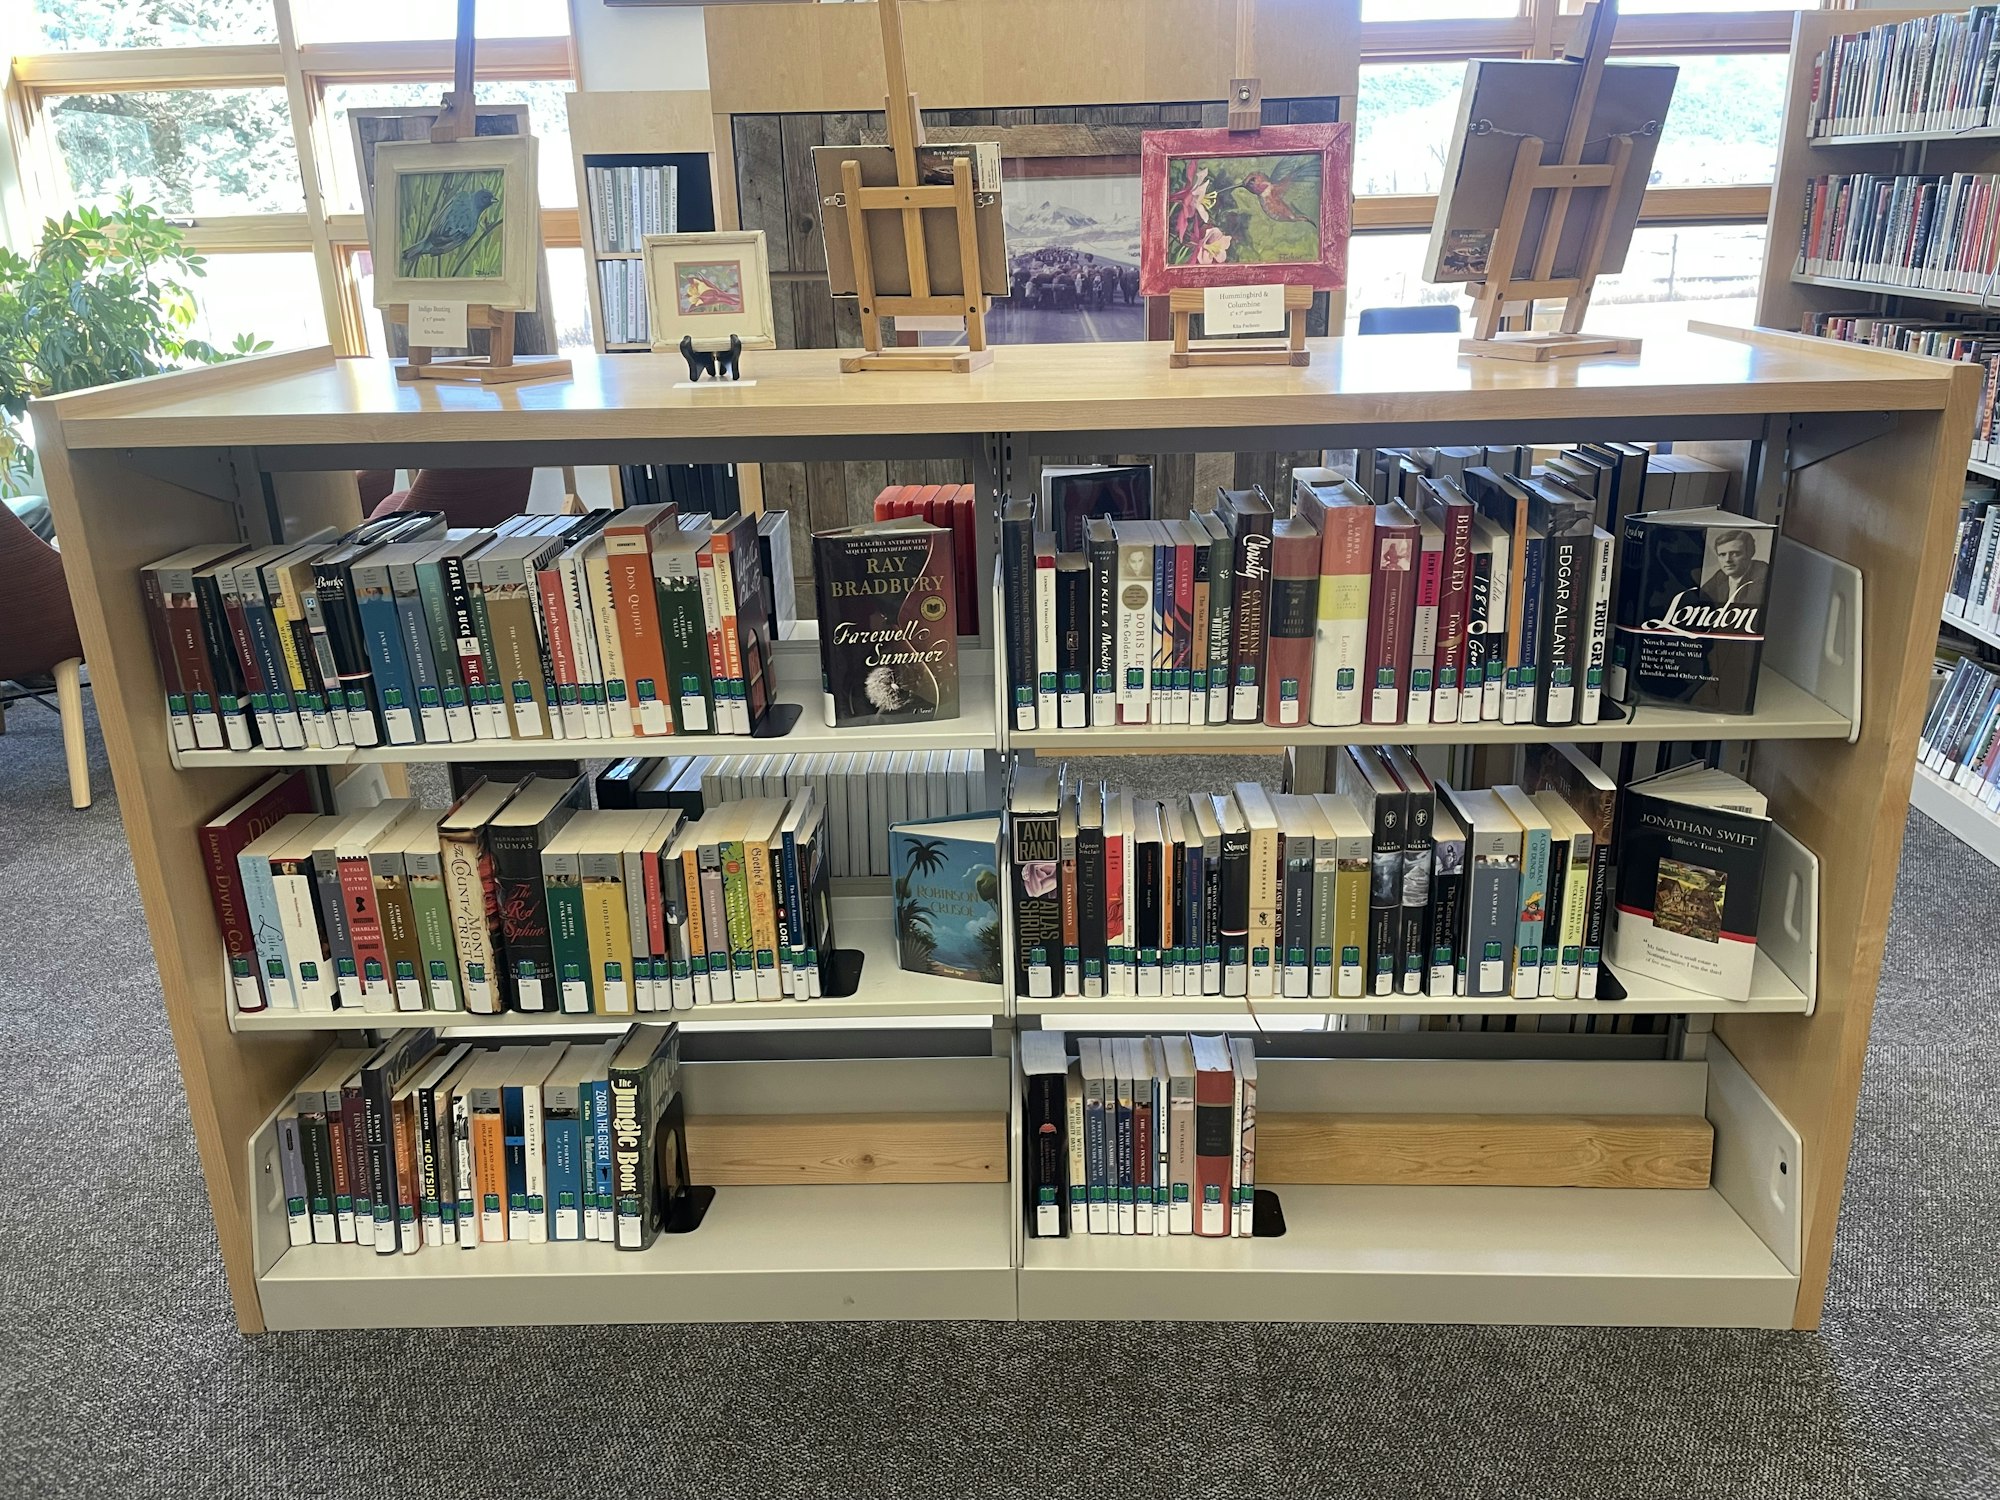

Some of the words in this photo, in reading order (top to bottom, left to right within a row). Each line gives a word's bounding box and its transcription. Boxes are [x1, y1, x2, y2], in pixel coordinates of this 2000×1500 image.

[1220, 291, 1262, 300] Hummingbird
[1353, 527, 1361, 556] LARRY
[1452, 514, 1469, 591] BELOVED
[866, 556, 908, 574] RAY
[1235, 534, 1271, 580] Christy
[1426, 553, 1435, 576] HENRY
[448, 560, 461, 591] PEARL
[525, 565, 535, 579] The
[625, 566, 635, 590] DON
[703, 572, 712, 596] Agatha
[719, 560, 728, 582] Agatha
[1102, 570, 1109, 583] TO
[1556, 545, 1573, 599] EDGAR
[528, 582, 539, 614] Stranger
[547, 592, 555, 606] The
[831, 575, 945, 598] BRADBURY
[1424, 579, 1434, 604] MILLER
[1472, 575, 1489, 617] 1984
[1492, 570, 1505, 602] Lolita
[454, 596, 464, 606] S.
[706, 597, 715, 624] Christie
[1222, 606, 1230, 618] The
[1641, 581, 1758, 639] London
[458, 610, 471, 636] BUCK
[549, 606, 560, 625] Early
[628, 594, 643, 638] QUIJOTE
[672, 618, 680, 638] TALES
[678, 606, 689, 648] CANTERBURY
[1123, 613, 1131, 628] The
[1211, 617, 1221, 640] WHITE
[1221, 620, 1230, 636] CALL
[1239, 590, 1250, 656] MARSHALL
[1249, 590, 1262, 656] CATHERINE
[1449, 612, 1460, 640] Toni
[1593, 600, 1607, 638] TRUE
[186, 628, 194, 648] EMMA
[553, 626, 564, 650] Stories
[727, 628, 735, 639] THE
[833, 620, 931, 645] Farewell
[1136, 613, 1145, 648] DORIS
[1552, 604, 1568, 655] ALLAN
[238, 629, 252, 666] PERSUASION
[256, 618, 265, 639] SENSE
[264, 649, 278, 690] SENSIBILITY
[408, 612, 419, 651] WUTHERING
[416, 654, 426, 682] HEIGHTS
[512, 642, 522, 669] ARABIAN
[728, 640, 737, 655] BODY
[865, 639, 950, 667] Summer
[1123, 630, 1131, 659] Golden
[1211, 642, 1220, 660] FANG
[1643, 639, 1665, 648] Novels
[1680, 641, 1703, 649] Stories
[468, 660, 477, 674] THE
[1641, 655, 1658, 663] White
[1639, 670, 1666, 678] Klondike
[1602, 802, 1612, 828] TWAIN
[1023, 822, 1051, 840] AYN
[1640, 813, 1713, 837] JONATHAN
[1716, 829, 1758, 846] SWIFT
[209, 834, 225, 870] DANTE'S
[454, 844, 463, 858] The
[496, 842, 533, 850] DUMAS
[1019, 841, 1056, 860] RAND
[1598, 848, 1607, 863] THE
[1667, 835, 1698, 849] Gulliver's
[1701, 841, 1724, 854] Travels
[752, 848, 765, 886] Goethe's
[1085, 859, 1094, 878] THE
[1529, 852, 1538, 879] DUNCES
[1536, 839, 1546, 887] CONFEDERACY
[451, 858, 473, 906] COUNT
[512, 884, 532, 900] The
[916, 885, 980, 901] ROBINSON
[1594, 865, 1606, 909] INNOCENTS
[216, 875, 236, 925] DIVINE
[754, 892, 767, 917] Faust
[930, 902, 974, 917] CRUSOE
[1084, 882, 1095, 919] JUNGLE
[1569, 880, 1578, 924] HUCKLEBERRY
[1576, 886, 1584, 924] ADVENTURES
[332, 900, 340, 921] OLIVER
[336, 923, 344, 941] TWIST
[387, 902, 398, 940] PUNISHMENT
[394, 904, 402, 924] CRIME
[559, 900, 568, 939] MUSKETEERS
[691, 897, 699, 939] FITZGERALD
[1039, 900, 1059, 940] ATLAS
[1590, 911, 1601, 942] ABROAD
[259, 915, 284, 951] Little
[432, 921, 442, 951] BROTHERS
[602, 899, 612, 958] MIDDLEMARCH
[596, 1090, 608, 1117] ZORBA
[611, 1080, 641, 1148] Jungle
[353, 1112, 364, 1142] ERNEST
[364, 1099, 373, 1142] HEMINGWAY
[394, 1113, 402, 1137] ERNEST
[598, 1118, 608, 1134] THE
[396, 1138, 405, 1175] HEMINGWAY
[598, 1135, 609, 1160] GREEK
[356, 1144, 367, 1194] HEMINGWAY
[372, 1155, 381, 1182] FAREWELL
